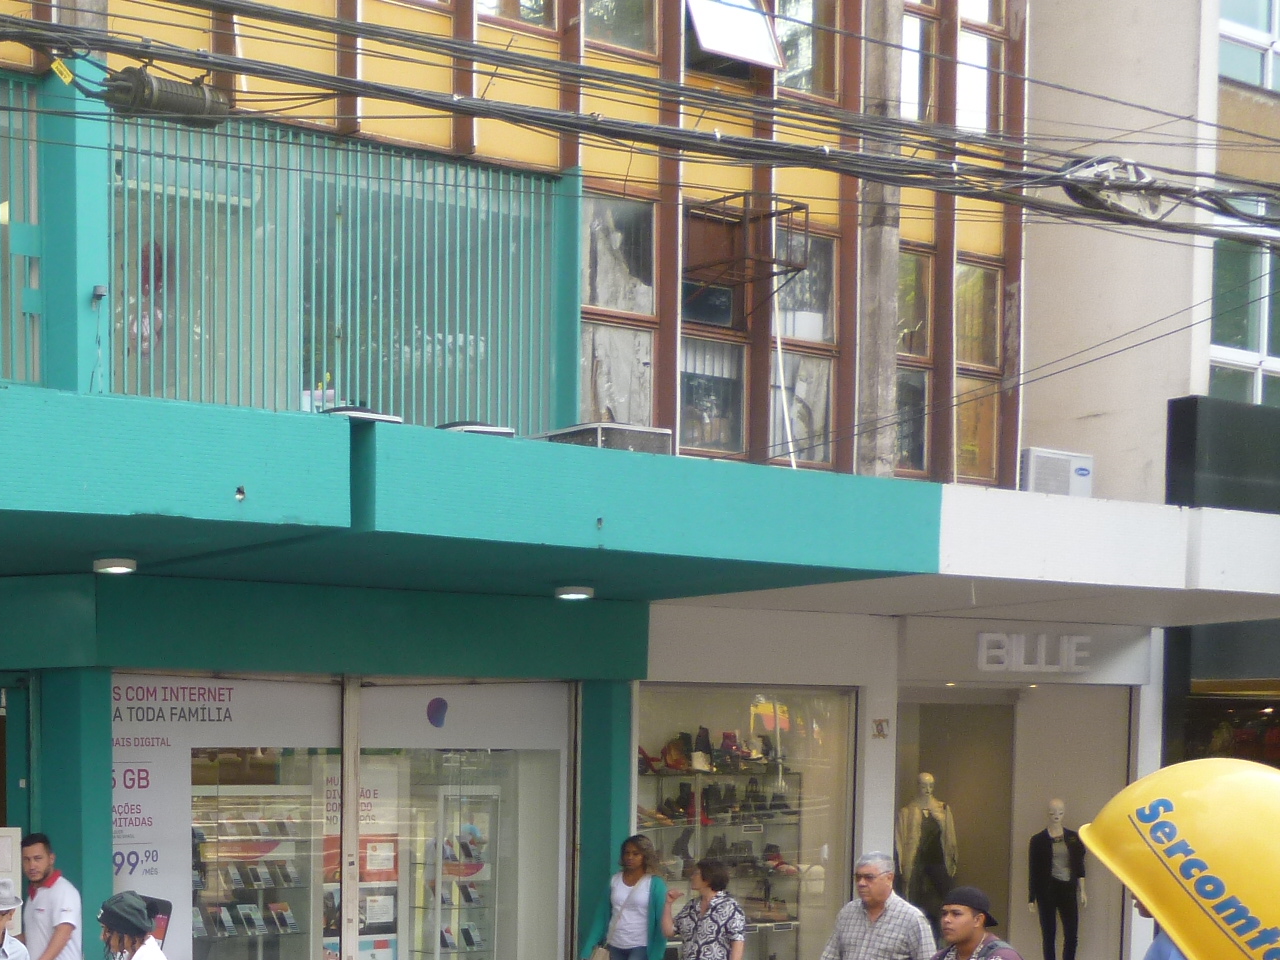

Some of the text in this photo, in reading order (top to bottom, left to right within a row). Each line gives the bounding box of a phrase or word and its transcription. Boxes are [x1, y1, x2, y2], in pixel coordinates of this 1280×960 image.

[978, 632, 1092, 673] BILLIE
[125, 686, 158, 702] COM
[161, 686, 234, 702] INTERNET
[126, 706, 166, 722] TODA
[169, 703, 233, 722] FAMÍLIA
[133, 737, 172, 748] DIGITAL
[123, 768, 150, 790] GB
